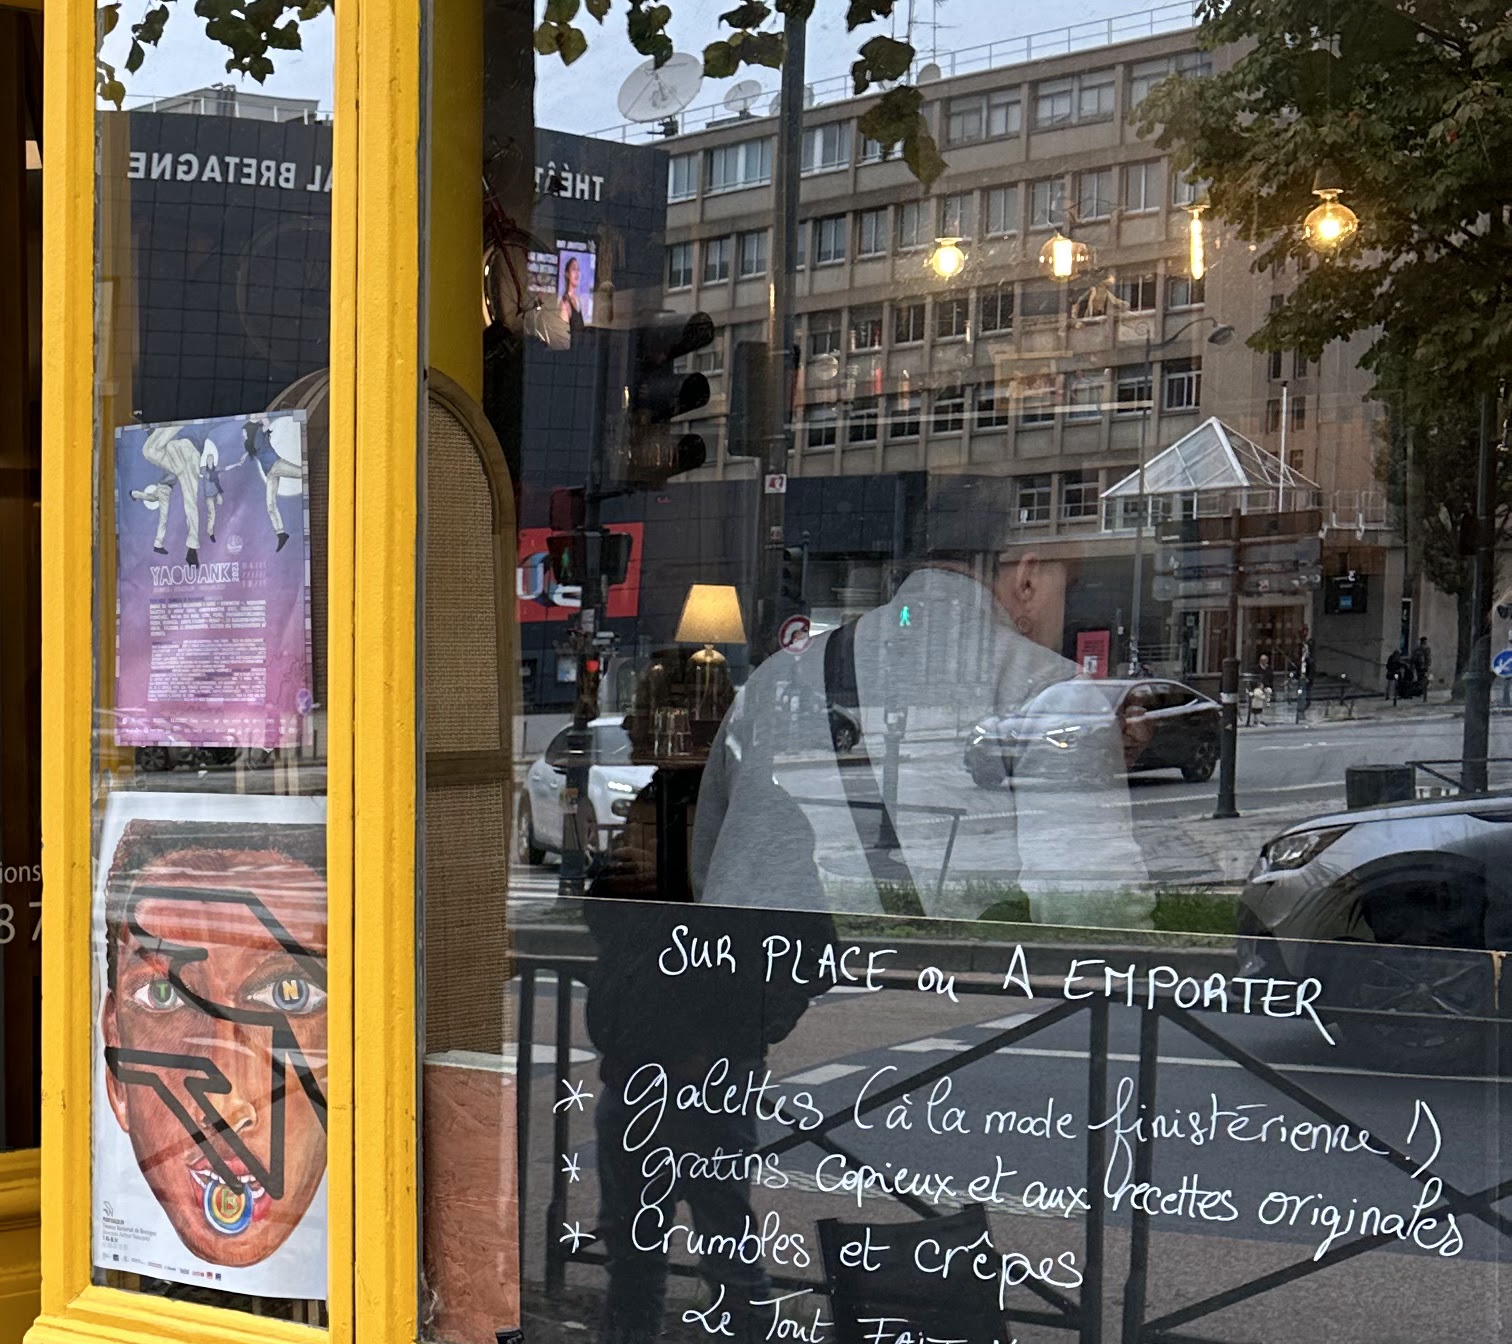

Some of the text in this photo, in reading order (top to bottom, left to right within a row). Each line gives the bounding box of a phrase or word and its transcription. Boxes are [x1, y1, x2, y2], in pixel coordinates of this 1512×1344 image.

[149, 562, 232, 586] YAOUANK
[763, 935, 898, 992] PLACE
[917, 964, 959, 1003] ou
[1003, 945, 1033, 999] A
[1063, 958, 1336, 1045] EMPORTER
[927, 1076, 970, 1134] la
[985, 1098, 1077, 1139] mode
[967, 1155, 1018, 1204] et
[1022, 1180, 1090, 1218] aux
[1109, 1174, 1239, 1222] recettes
[839, 1227, 891, 1273] et
[682, 1284, 735, 1337] Le
